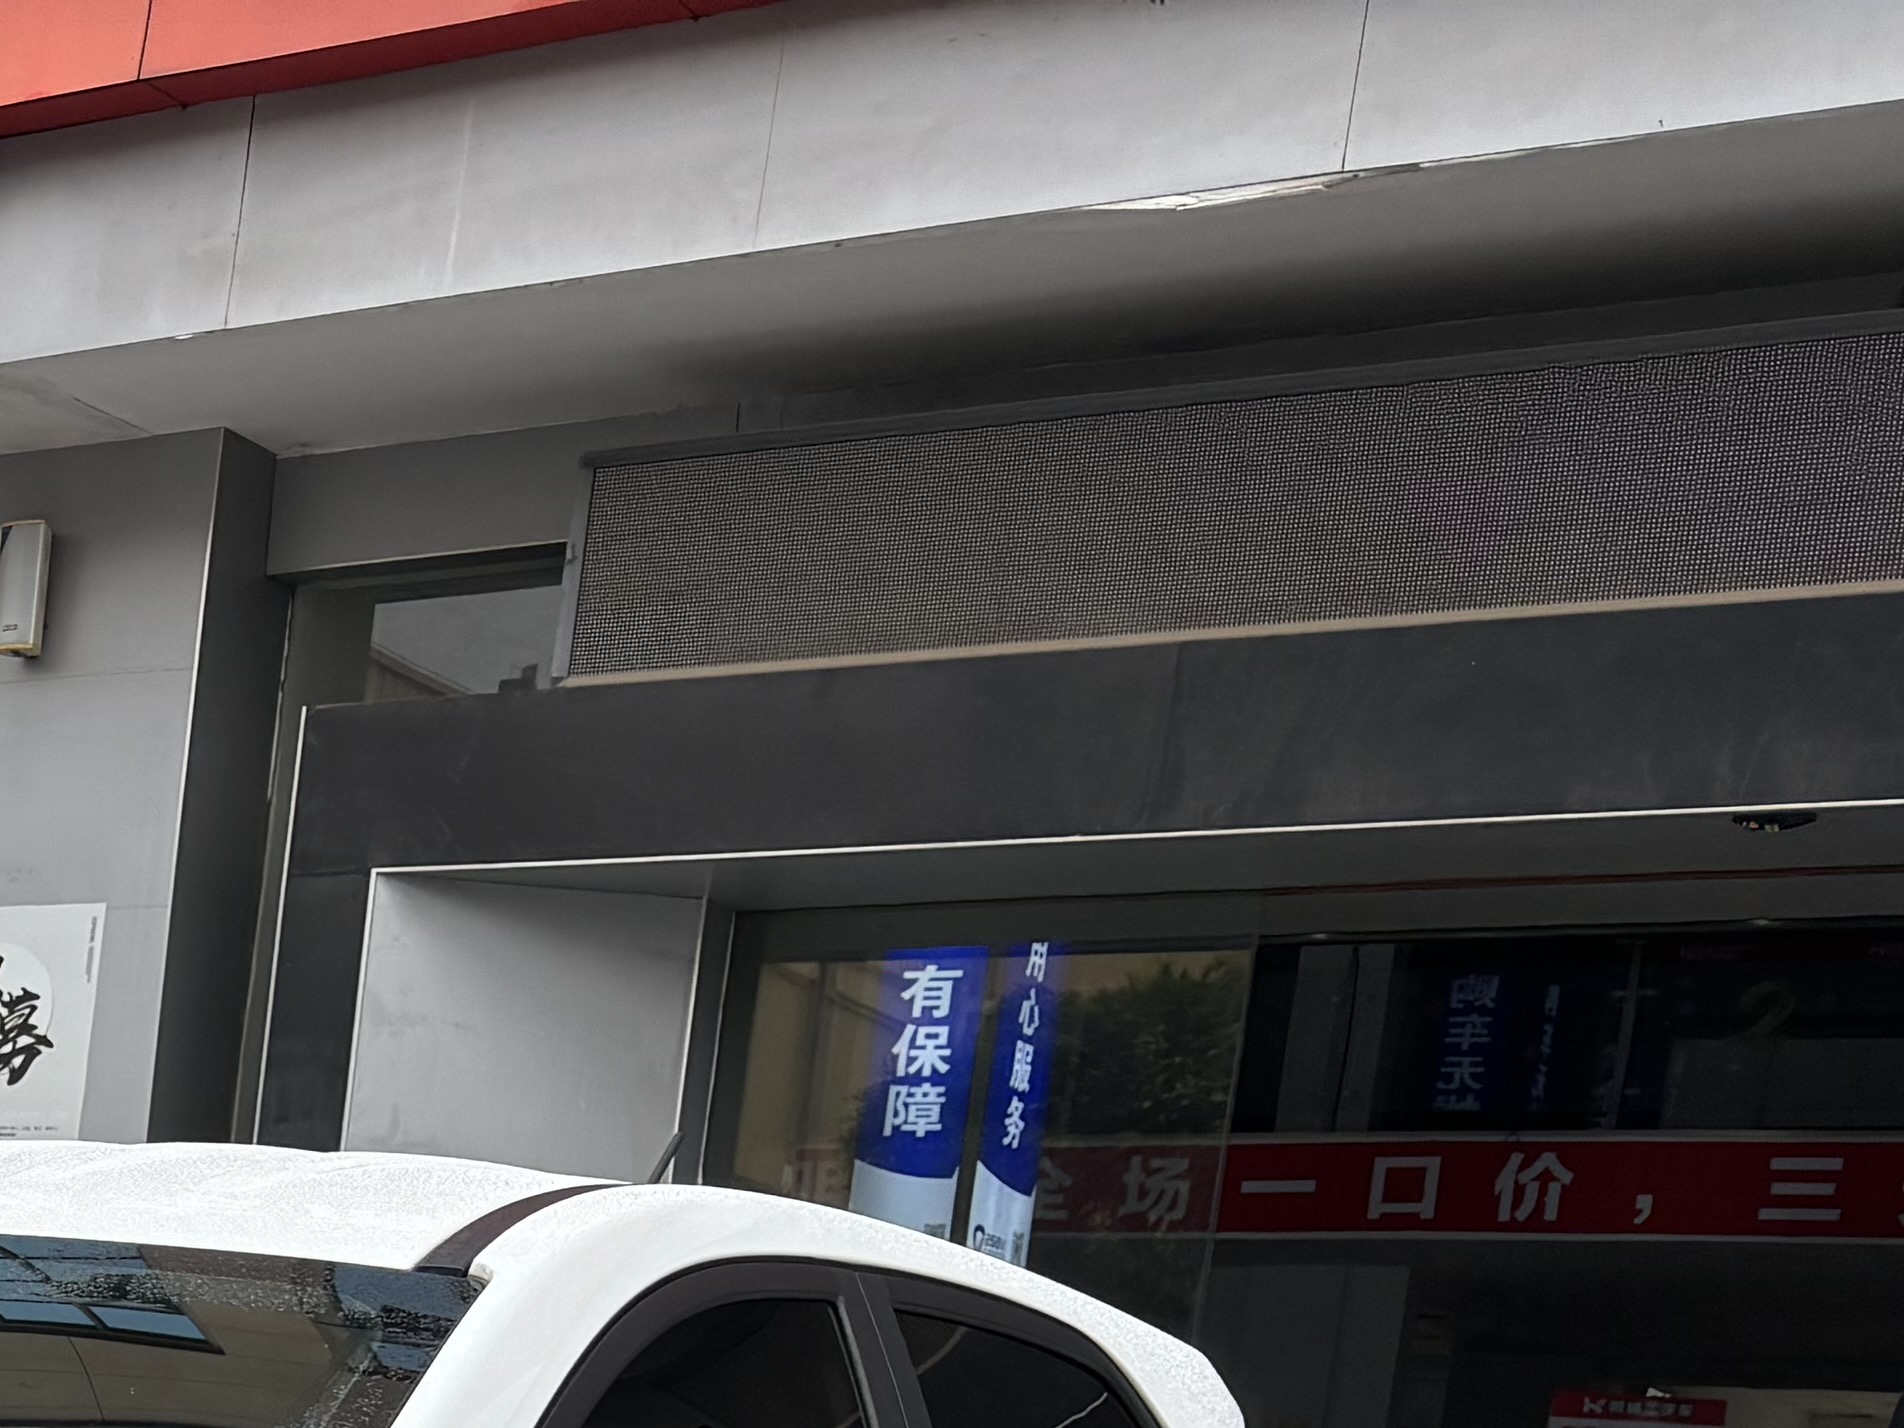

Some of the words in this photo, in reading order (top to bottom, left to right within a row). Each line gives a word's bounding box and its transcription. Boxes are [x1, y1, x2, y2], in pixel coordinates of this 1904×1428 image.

[881, 964, 964, 1139] 有保障
[1002, 941, 1049, 1150] 用心服务
[1036, 1150, 1904, 1226] 全场一口价，三
